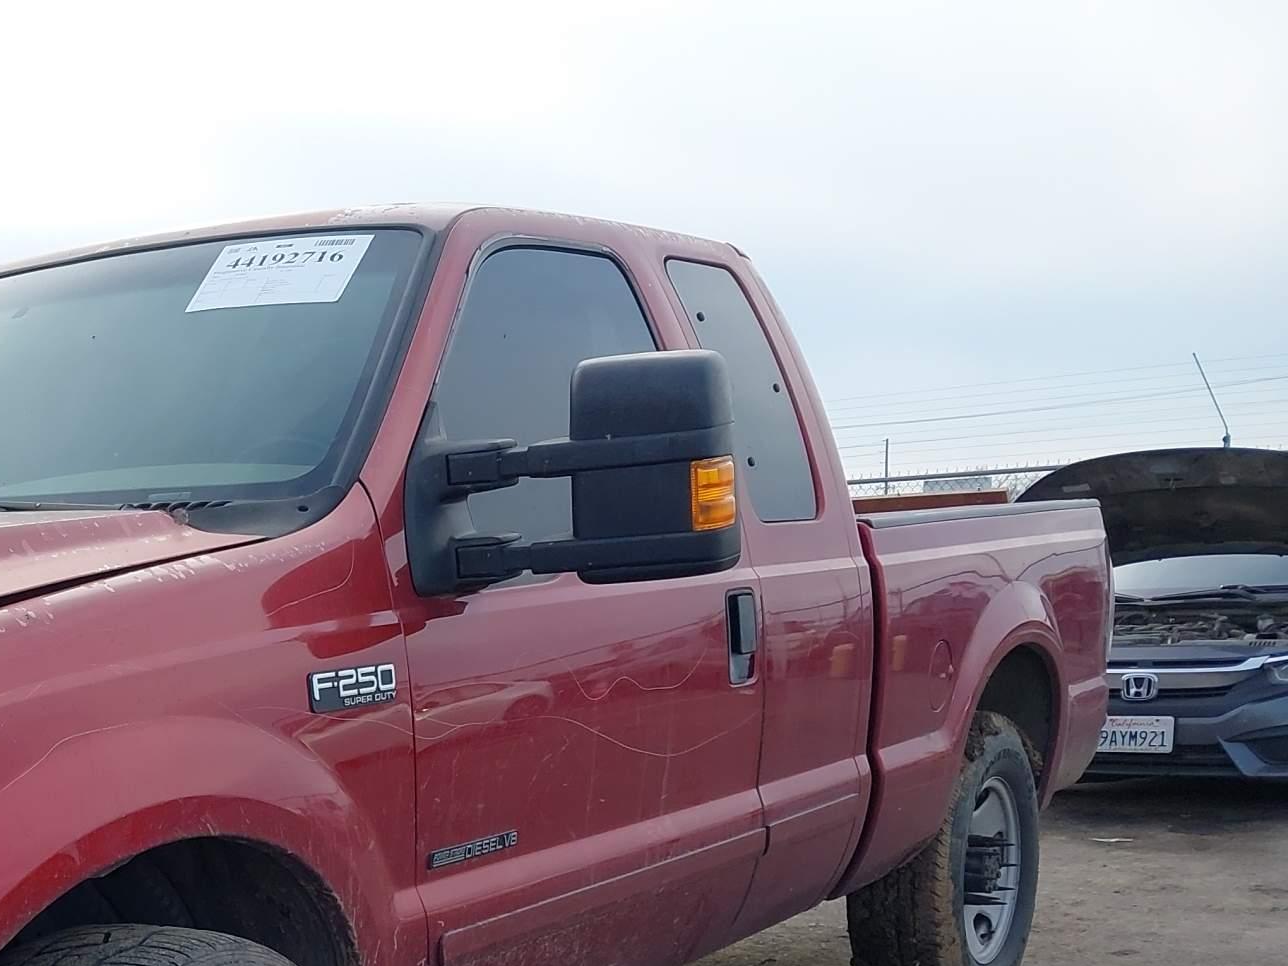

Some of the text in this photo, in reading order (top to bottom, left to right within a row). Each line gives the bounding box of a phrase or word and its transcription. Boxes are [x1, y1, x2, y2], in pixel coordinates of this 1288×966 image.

[225, 250, 345, 269] 44192716
[343, 690, 397, 706] SUPER DUTY
[1111, 717, 1155, 729] California
[1099, 730, 1168, 747] 9AYM921
[465, 836, 503, 858] DIESEL
[503, 831, 518, 848] V8
